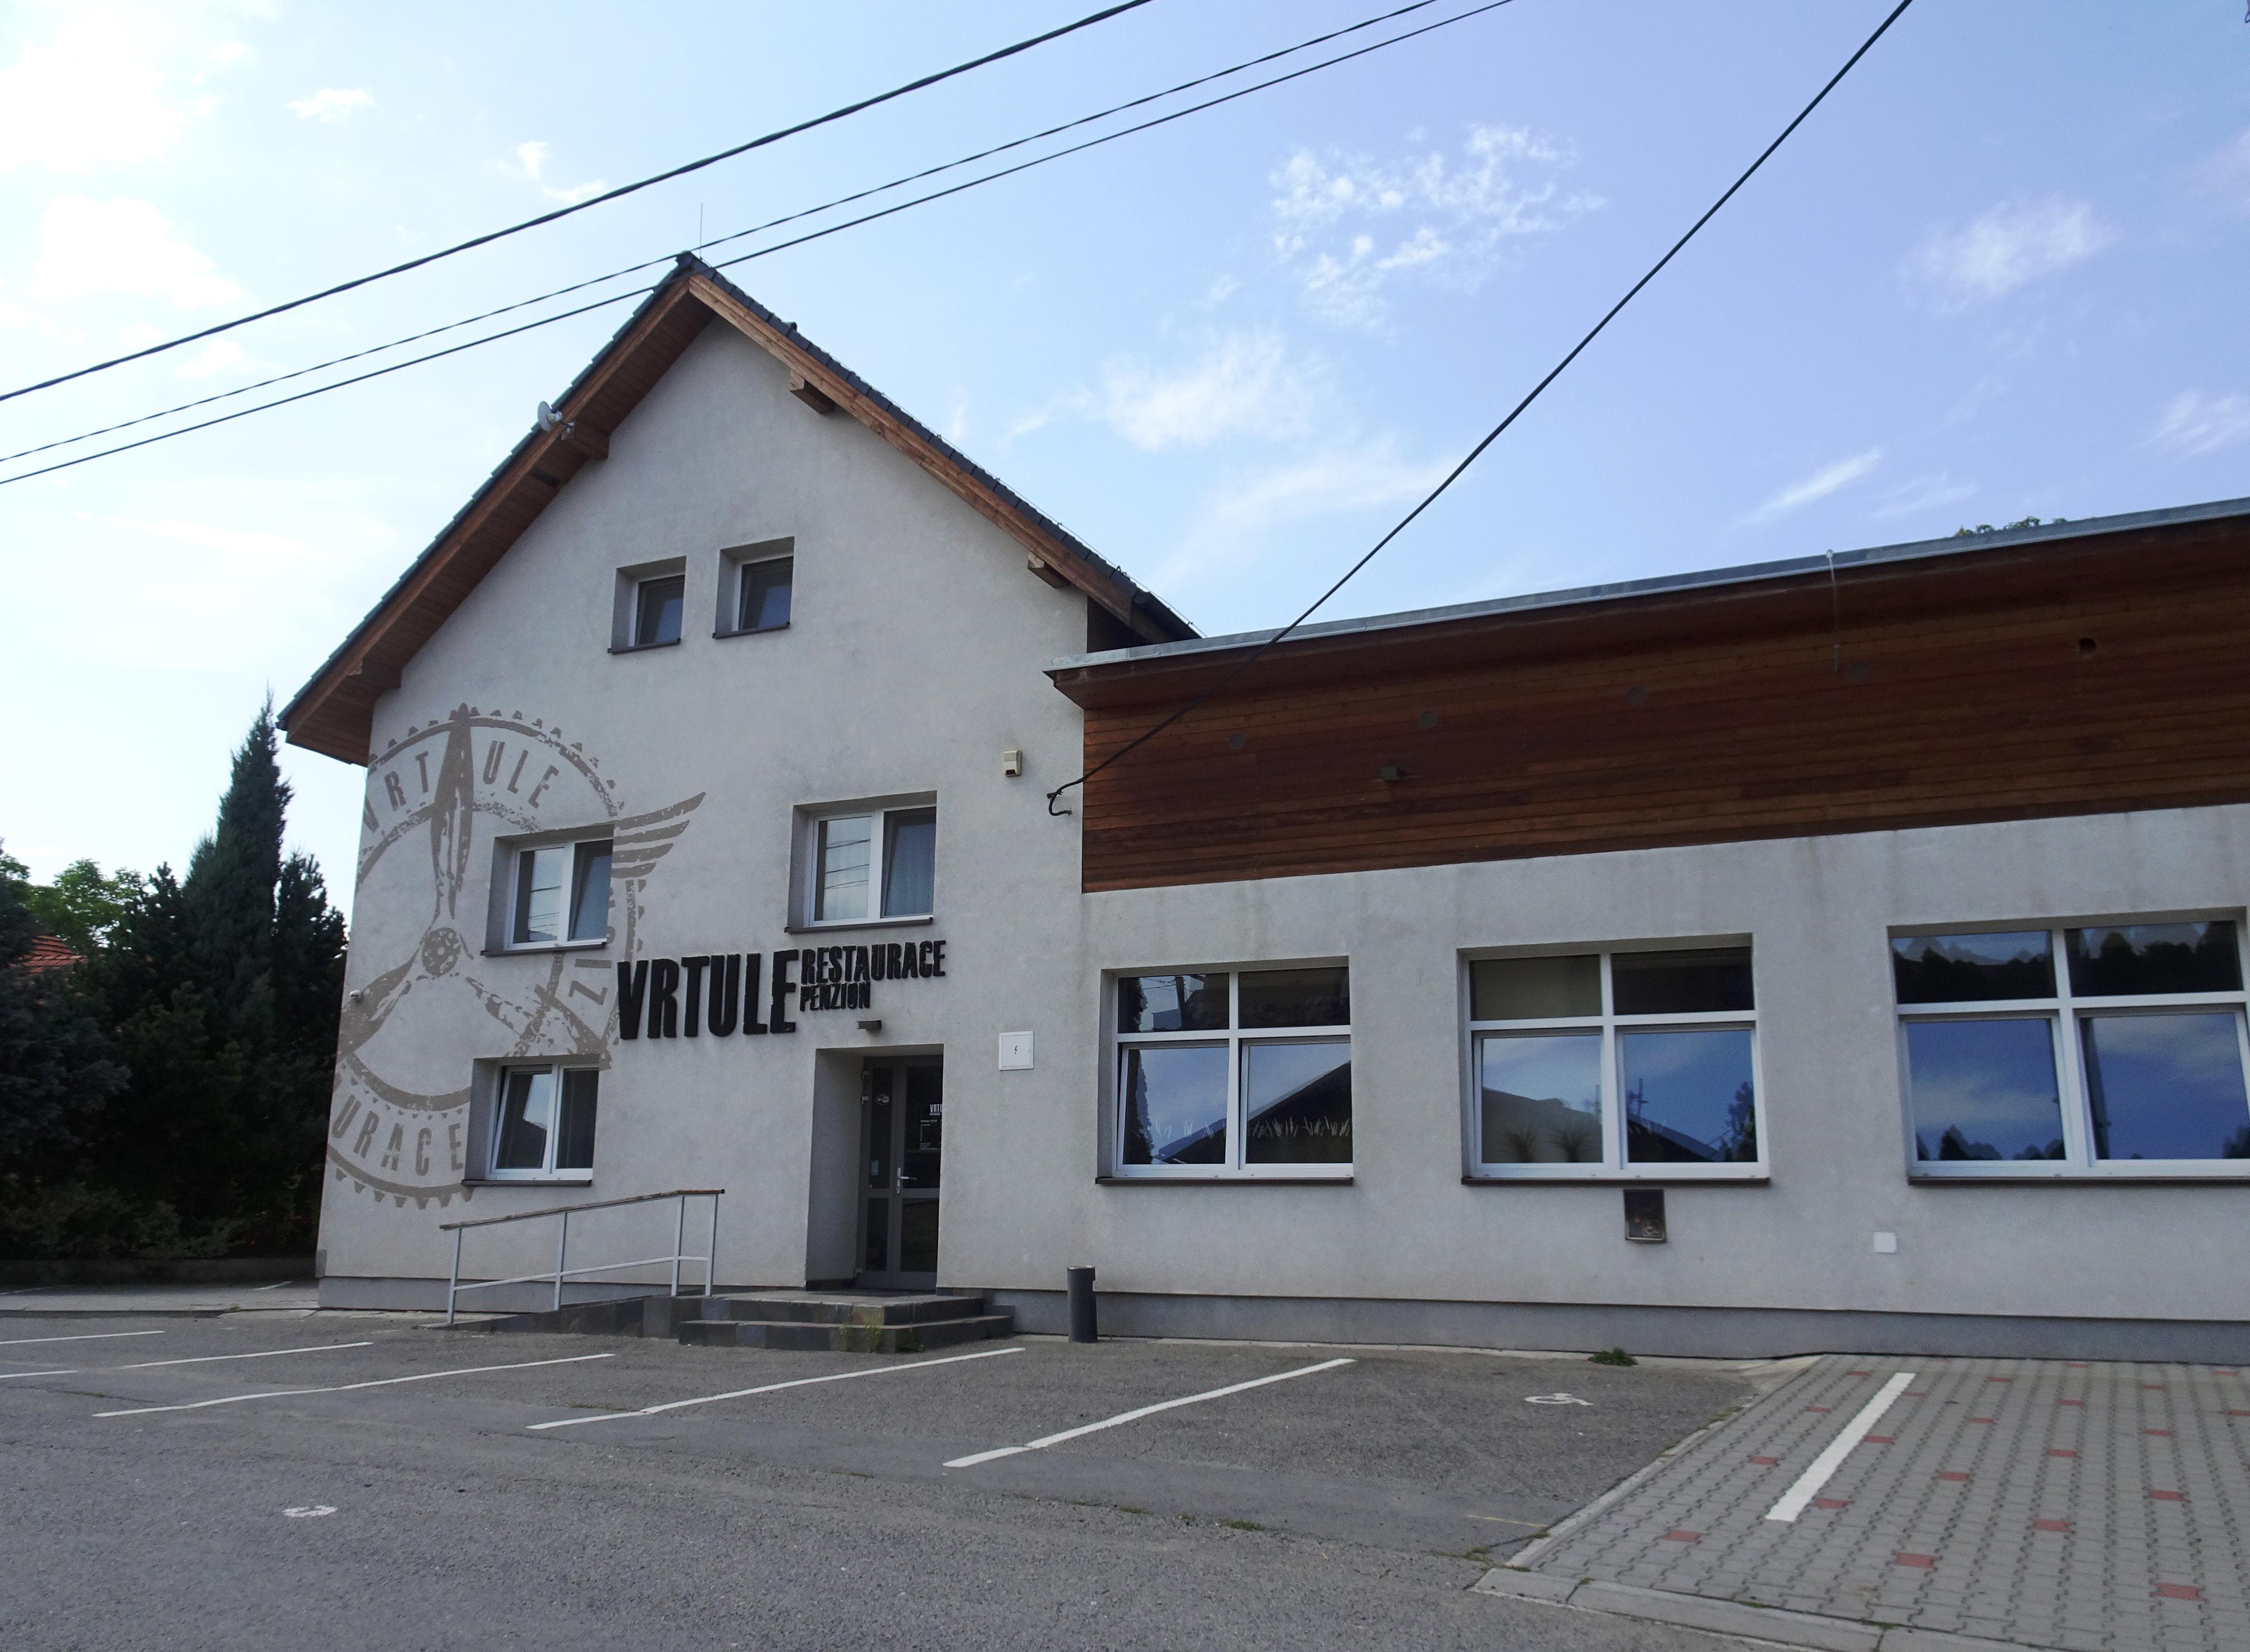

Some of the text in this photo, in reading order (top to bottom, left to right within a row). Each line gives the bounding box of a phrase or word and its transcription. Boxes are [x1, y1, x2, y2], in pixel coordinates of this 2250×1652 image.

[801, 940, 946, 984] RESTAURACE
[617, 949, 799, 1039] VRTULE
[799, 981, 871, 1011] PENZION
